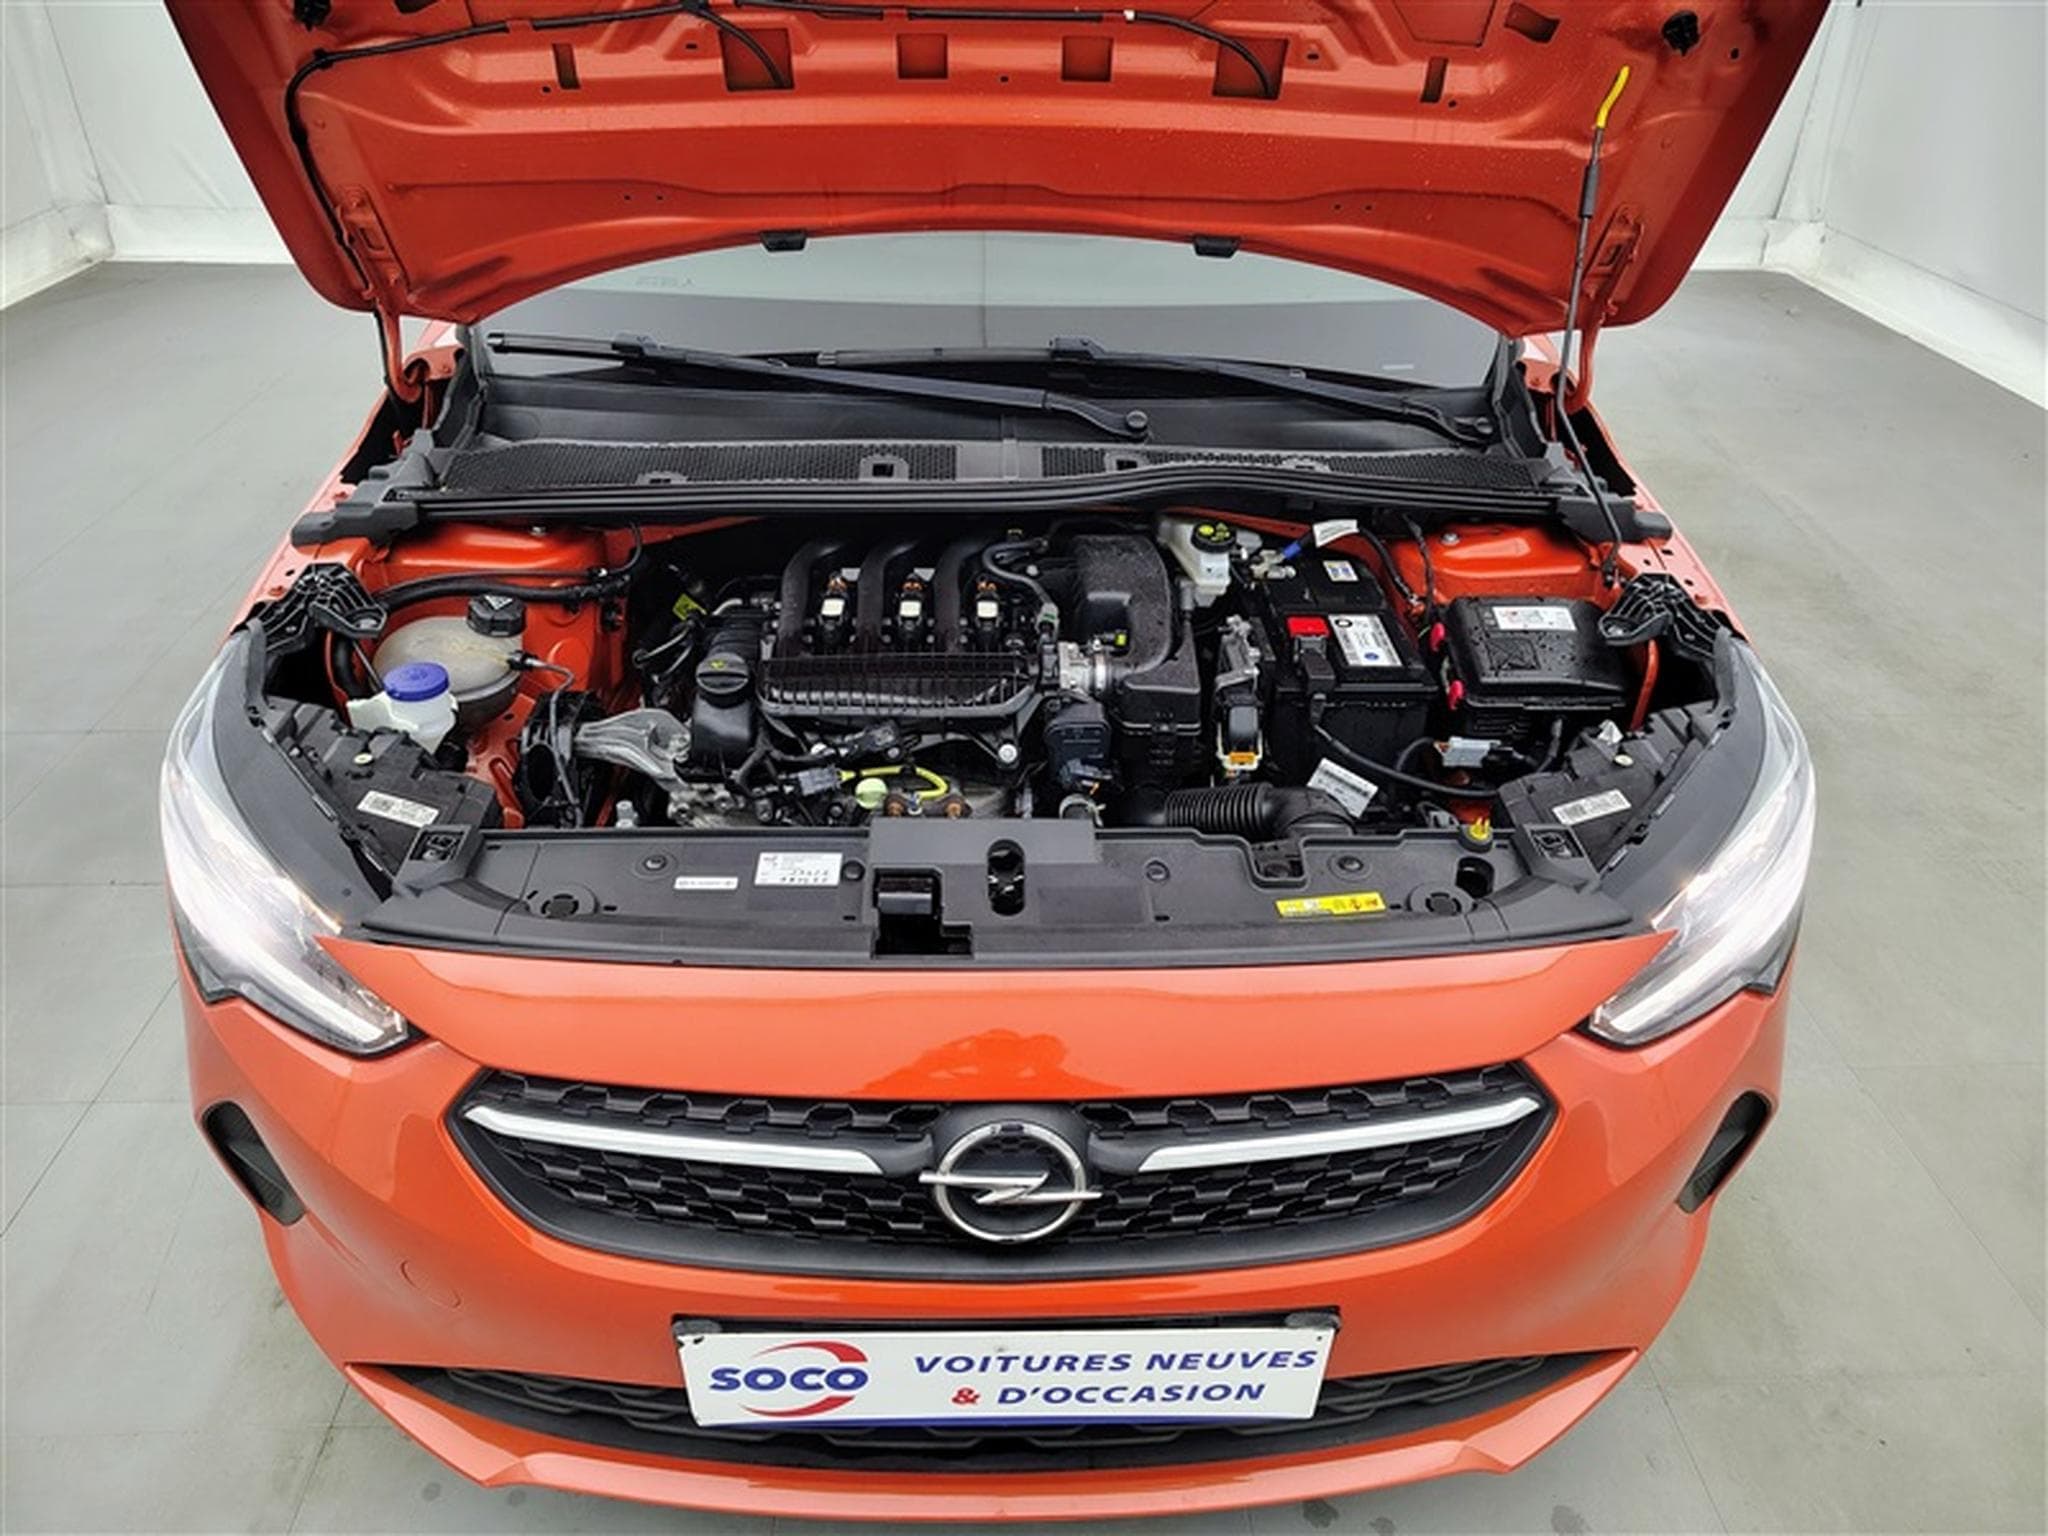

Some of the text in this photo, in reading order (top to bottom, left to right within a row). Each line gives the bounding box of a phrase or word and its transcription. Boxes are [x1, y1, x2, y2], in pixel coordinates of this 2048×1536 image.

[914, 1350, 1317, 1373] VOITURES NEUVES
[710, 1366, 868, 1391] SOCO
[952, 1384, 1265, 1405] & D'OCCASION
